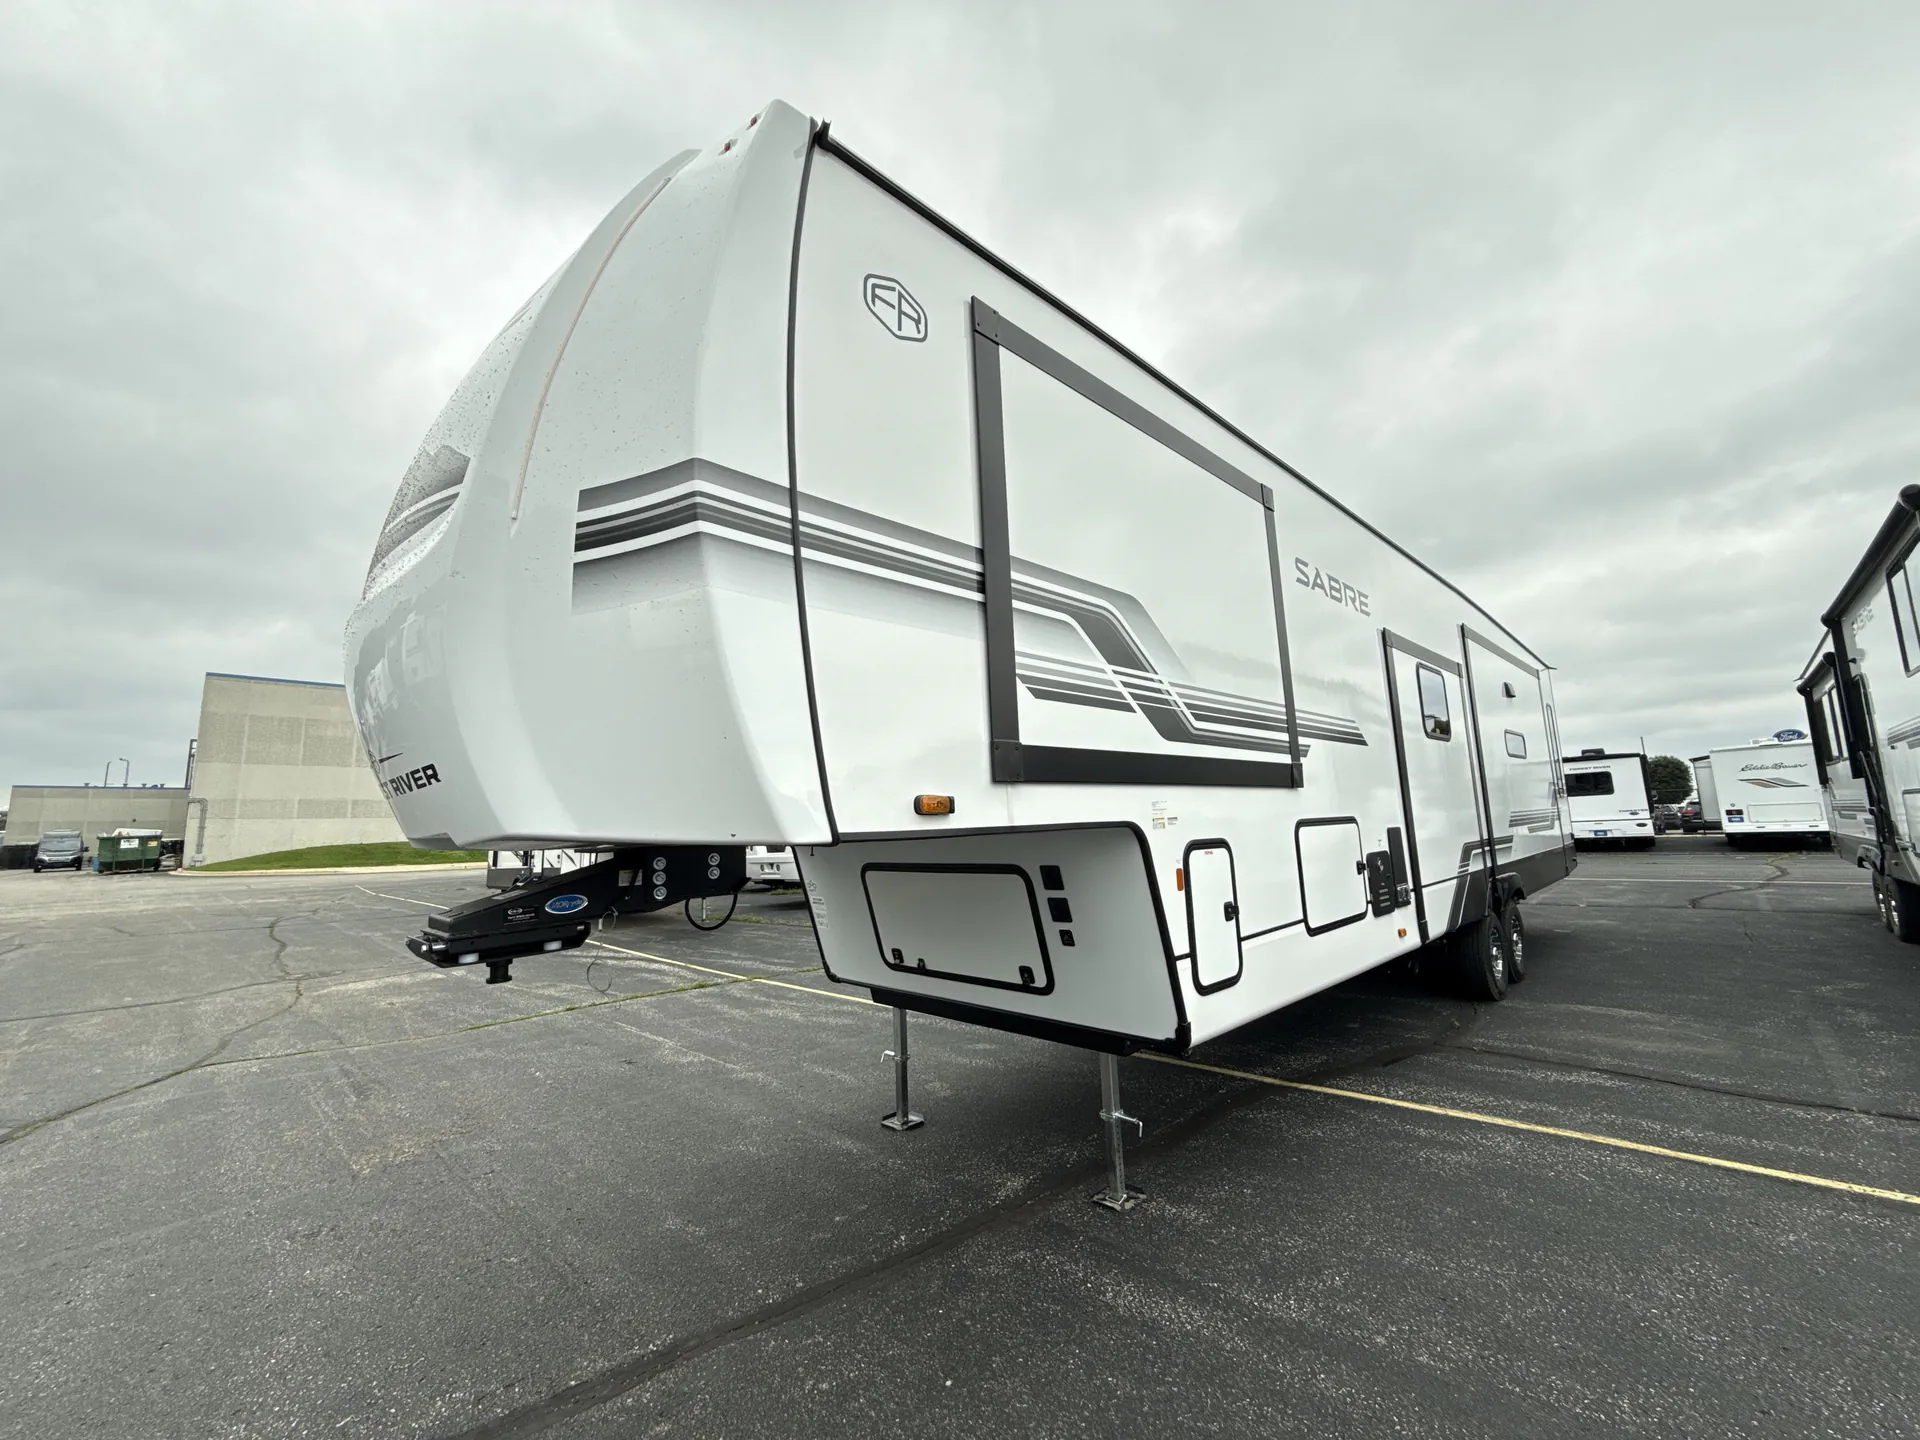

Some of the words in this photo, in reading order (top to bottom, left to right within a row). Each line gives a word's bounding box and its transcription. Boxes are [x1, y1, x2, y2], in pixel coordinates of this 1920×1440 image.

[1294, 556, 1371, 618] SABRE
[1779, 731, 1799, 741] Ford
[1739, 764, 1769, 773] Eddie
[1768, 762, 1808, 771] Bauer
[388, 763, 442, 797] RIVER
